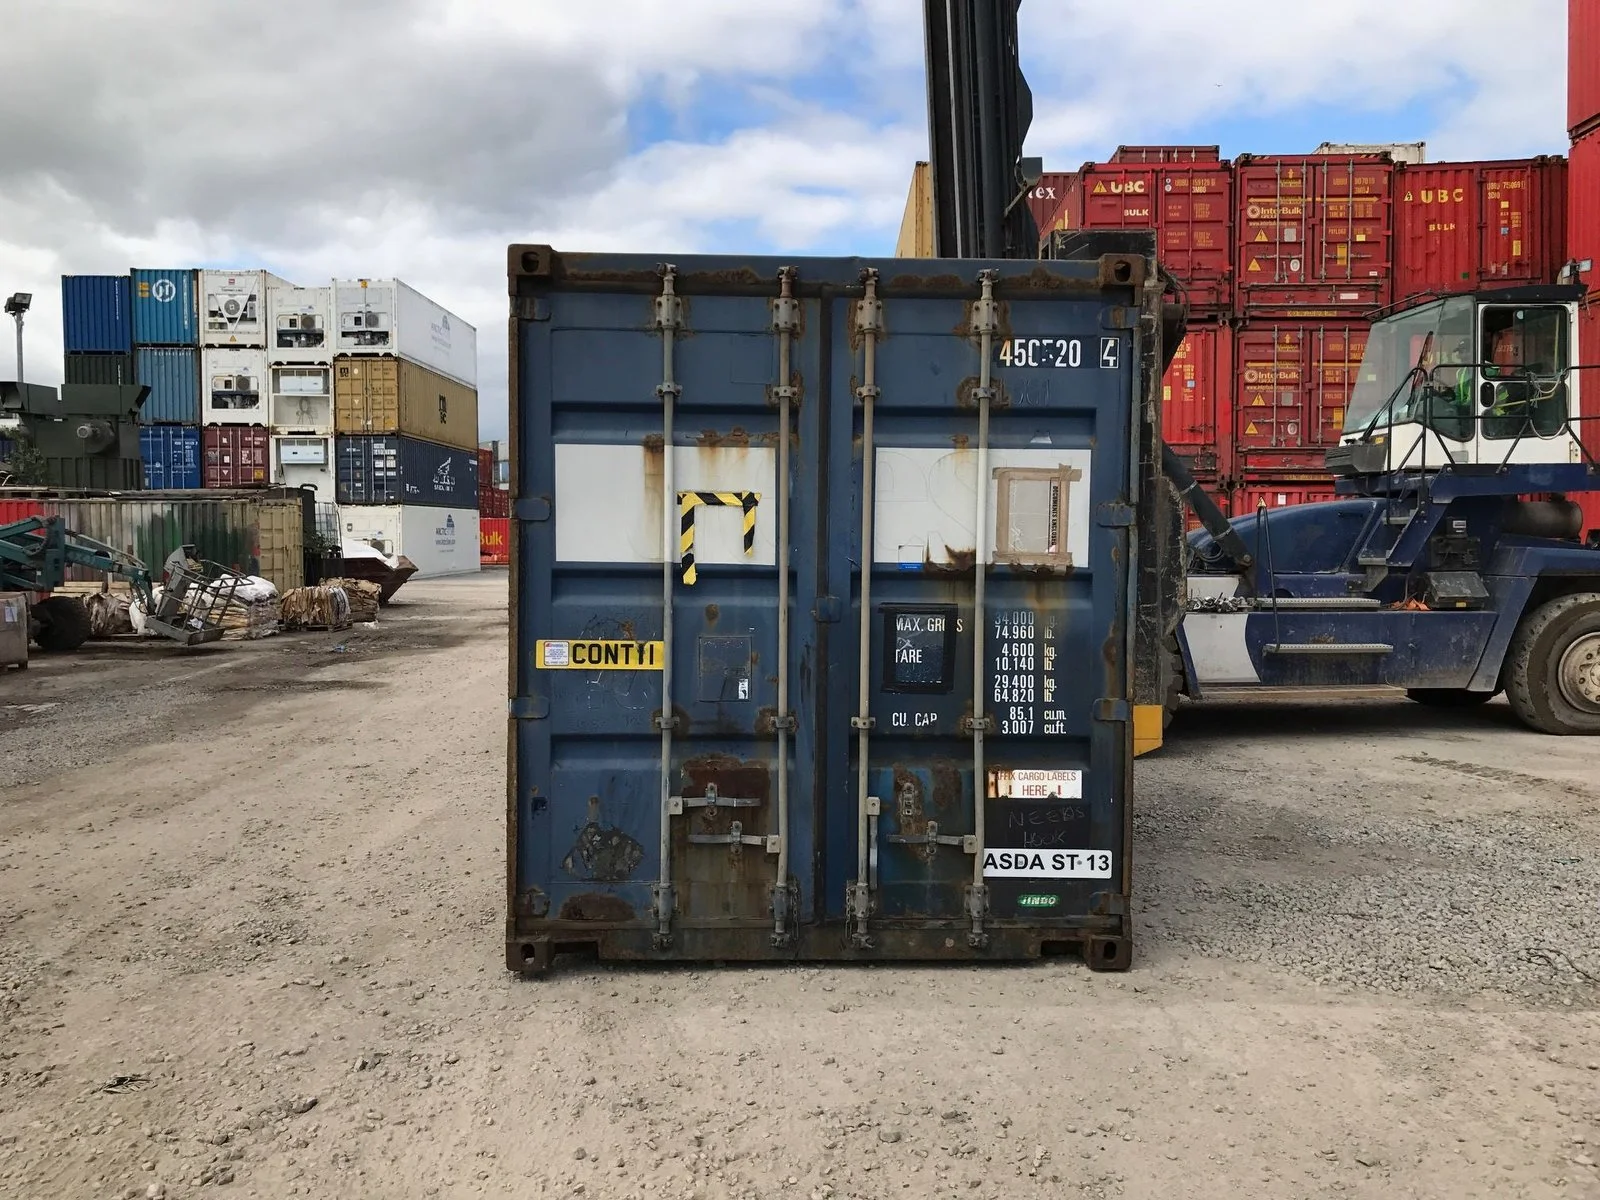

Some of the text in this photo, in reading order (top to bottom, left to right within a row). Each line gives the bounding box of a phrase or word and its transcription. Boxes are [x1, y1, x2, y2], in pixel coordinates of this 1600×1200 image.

[1111, 180, 1145, 193] UBC
[1420, 189, 1464, 204] UBC
[1124, 208, 1149, 216] BULK
[1051, 485, 1059, 518] DOCUMENTS
[927, 618, 963, 632] GRS
[994, 611, 1035, 625] 34.000
[994, 625, 1055, 639] 74.960 lb.
[895, 649, 923, 664] TARE
[1001, 643, 1058, 661] 4.600 kg.
[994, 657, 1055, 671] 10.140 lb.
[994, 674, 1058, 692] 29.400 kg.
[994, 689, 1055, 703] 64.820 lb.
[1009, 706, 1034, 721] 85.1
[1002, 720, 1035, 734] 3.007
[1018, 772, 1045, 781] CARGO
[1047, 772, 1077, 781] LABELS
[1022, 785, 1048, 796] HERE
[983, 853, 1045, 871] ASDA
[1086, 855, 1110, 871] 13
